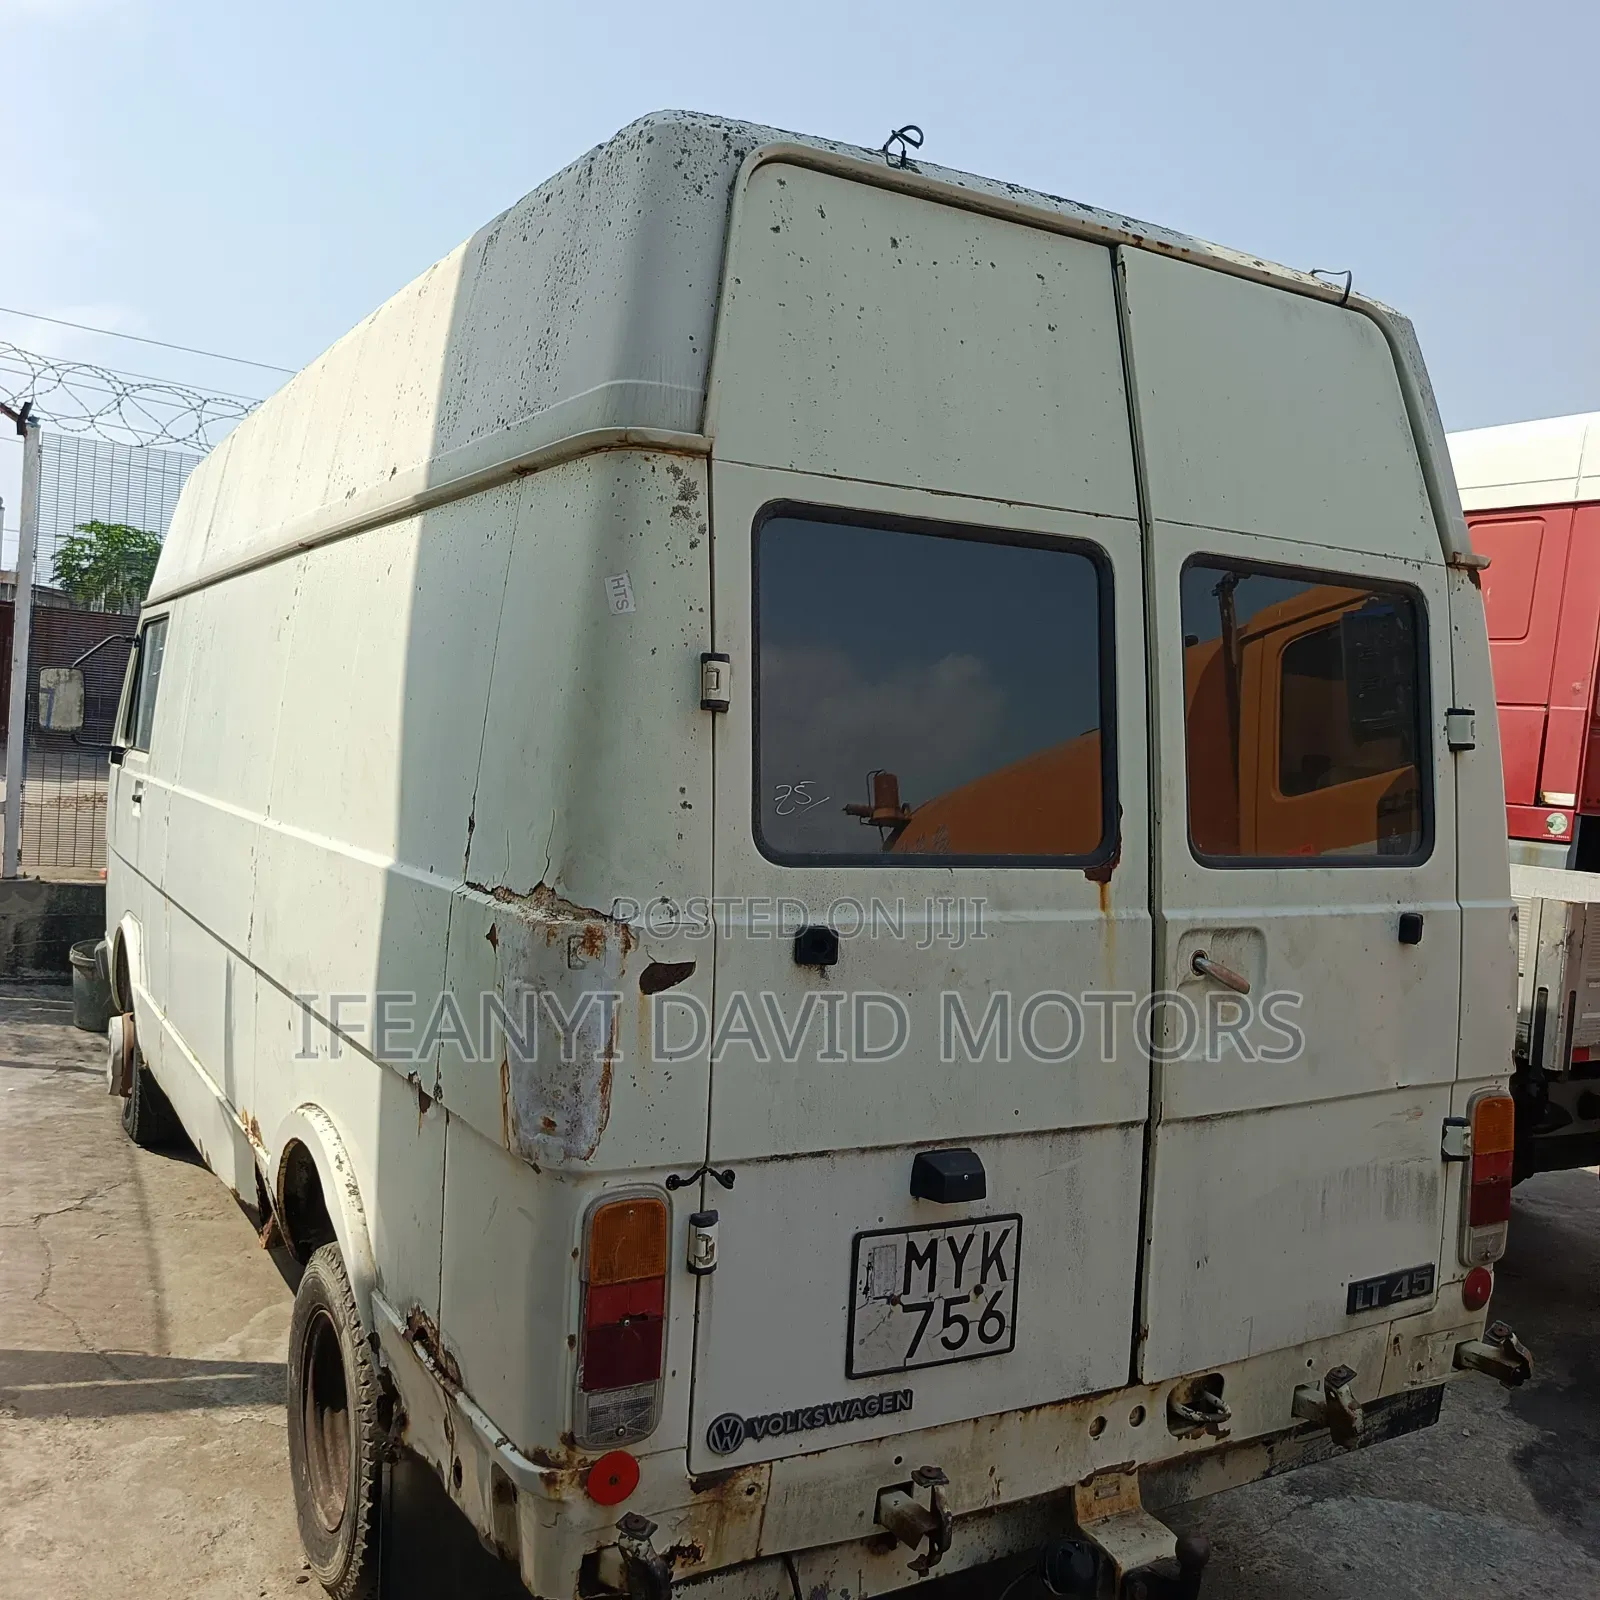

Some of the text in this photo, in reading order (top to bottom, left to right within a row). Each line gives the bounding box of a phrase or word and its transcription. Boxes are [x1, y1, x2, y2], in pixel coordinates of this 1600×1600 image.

[611, 577, 629, 611] HTS
[902, 1228, 1011, 1296] MYK
[1355, 1269, 1432, 1310] LT 45
[902, 1290, 1006, 1359] 756
[752, 1390, 912, 1438] VOLKSWAGEN
